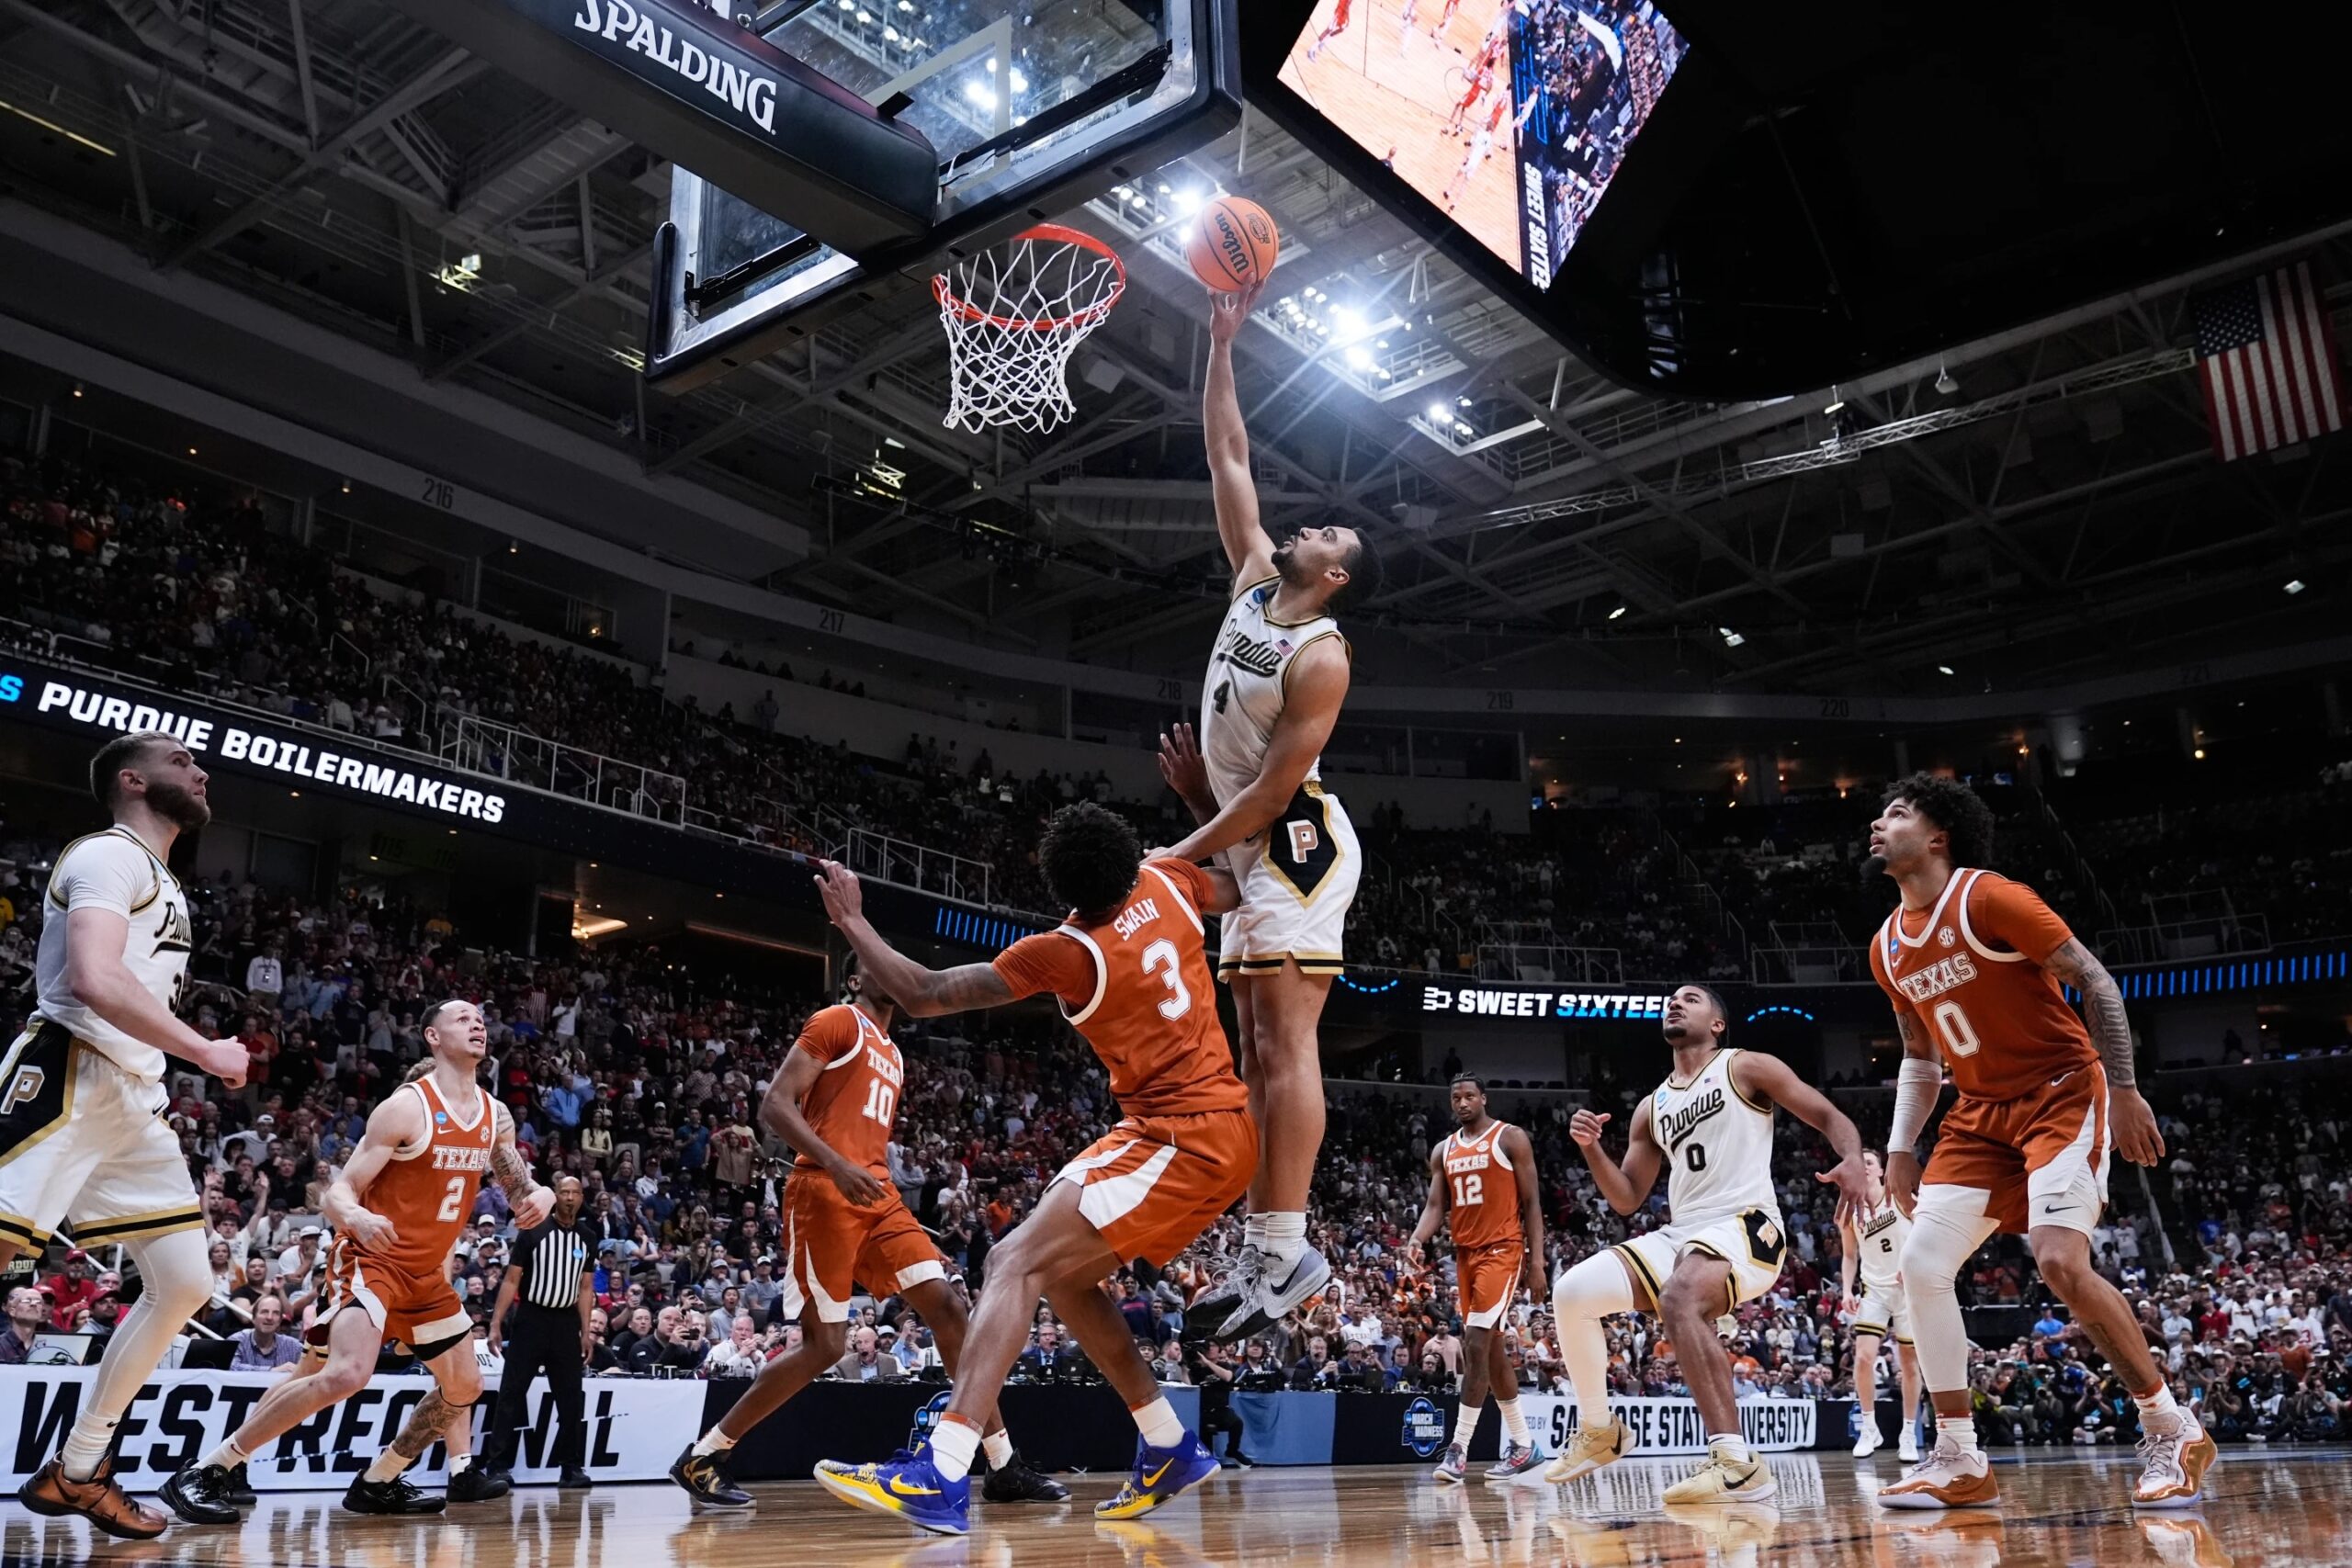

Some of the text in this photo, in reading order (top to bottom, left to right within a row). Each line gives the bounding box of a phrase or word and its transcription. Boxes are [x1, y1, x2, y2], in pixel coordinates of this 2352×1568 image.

[575, 0, 776, 135] SPALDING
[1215, 210, 1250, 275] Wilson
[1524, 162, 1552, 293] SWEET SIXTEE
[421, 477, 455, 510] 216
[819, 607, 845, 634] 217
[1217, 617, 1283, 677] Purdue
[1157, 678, 1182, 701] 218
[1213, 680, 1230, 715] 4
[1486, 691, 1514, 711] 219
[1820, 698, 1850, 718] 220
[38, 682, 214, 751] PURDUE
[220, 728, 506, 823] BOILERMAKERS
[1286, 819, 1318, 863] P
[1114, 897, 1160, 942] SWAIN
[1141, 937, 1192, 1021] 3
[1897, 951, 1978, 1004] TEXAS
[1457, 989, 1553, 1017] SWEET
[1934, 999, 1981, 1058] 0
[866, 1044, 900, 1089] TEXAS
[1, 1065, 45, 1114] P
[862, 1077, 893, 1128] 10
[1659, 1088, 1725, 1145] Purdue
[432, 1145, 490, 1171] TEXAS
[1447, 1154, 1489, 1175] TEXAS
[1686, 1143, 1706, 1172] 0
[436, 1176, 466, 1222] 2
[1454, 1174, 1484, 1207] 12
[1865, 1210, 1896, 1234] urdue
[7, 1259, 36, 1273] RDUE
[1881, 1238, 1893, 1253] 2
[13, 1382, 275, 1473] WEST
[1551, 1404, 1578, 1449] SA
[1609, 1405, 1652, 1449] OSE
[1736, 1405, 1810, 1445] IVERSITY
